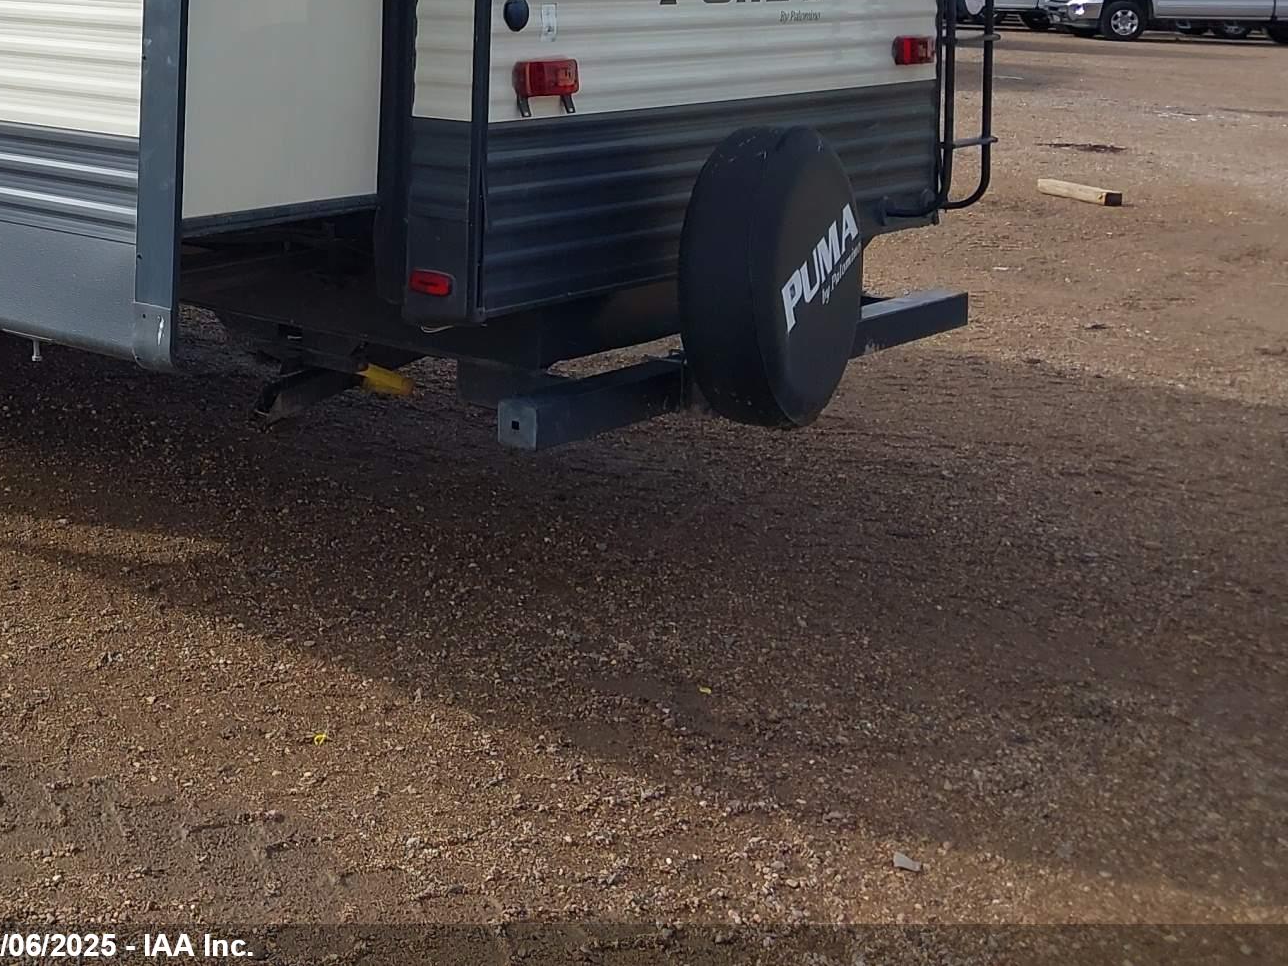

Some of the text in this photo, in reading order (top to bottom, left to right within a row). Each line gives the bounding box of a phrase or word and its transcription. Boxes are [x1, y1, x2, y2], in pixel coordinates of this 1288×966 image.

[779, 9, 821, 24] By Palomino
[780, 202, 859, 334] PUMA
[821, 284, 830, 305] by
